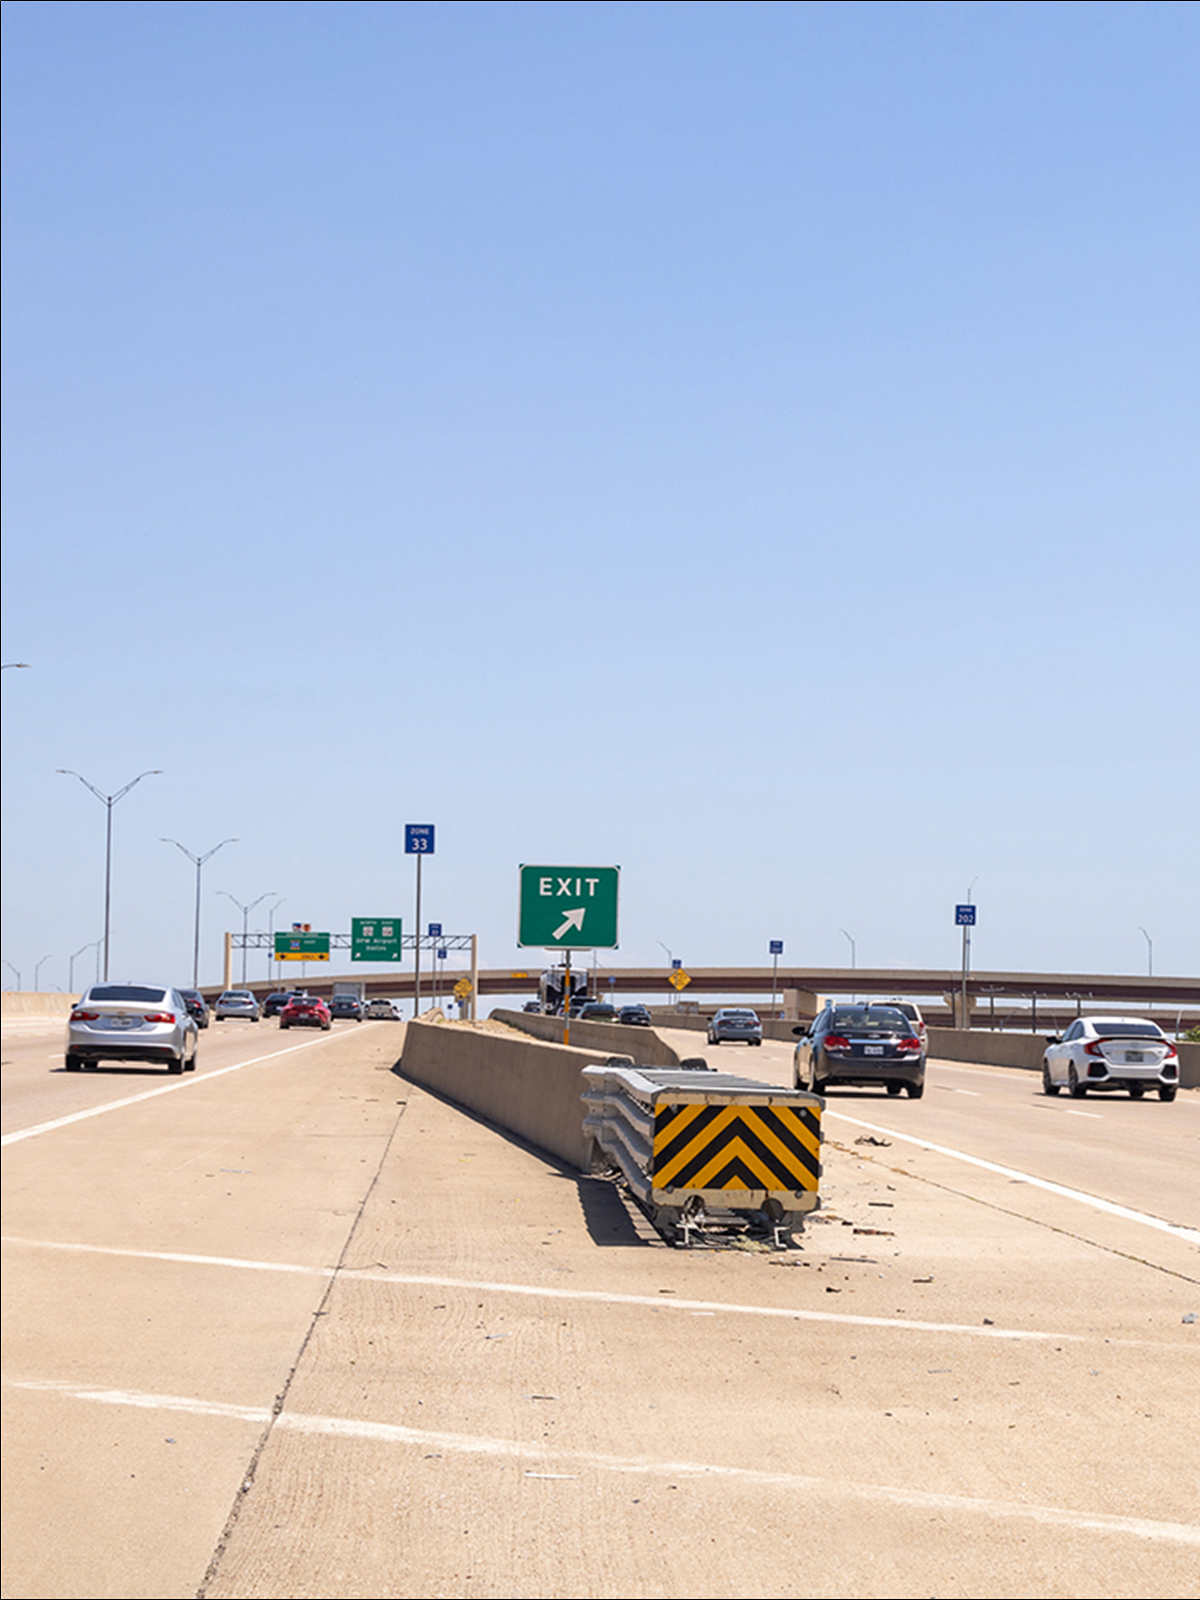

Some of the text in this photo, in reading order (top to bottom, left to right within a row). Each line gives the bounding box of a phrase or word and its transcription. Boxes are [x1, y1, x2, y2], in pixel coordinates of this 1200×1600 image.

[410, 827, 430, 835] ZONE
[411, 837, 428, 851] 33
[540, 877, 599, 897] EXIT
[958, 914, 974, 923] 202
